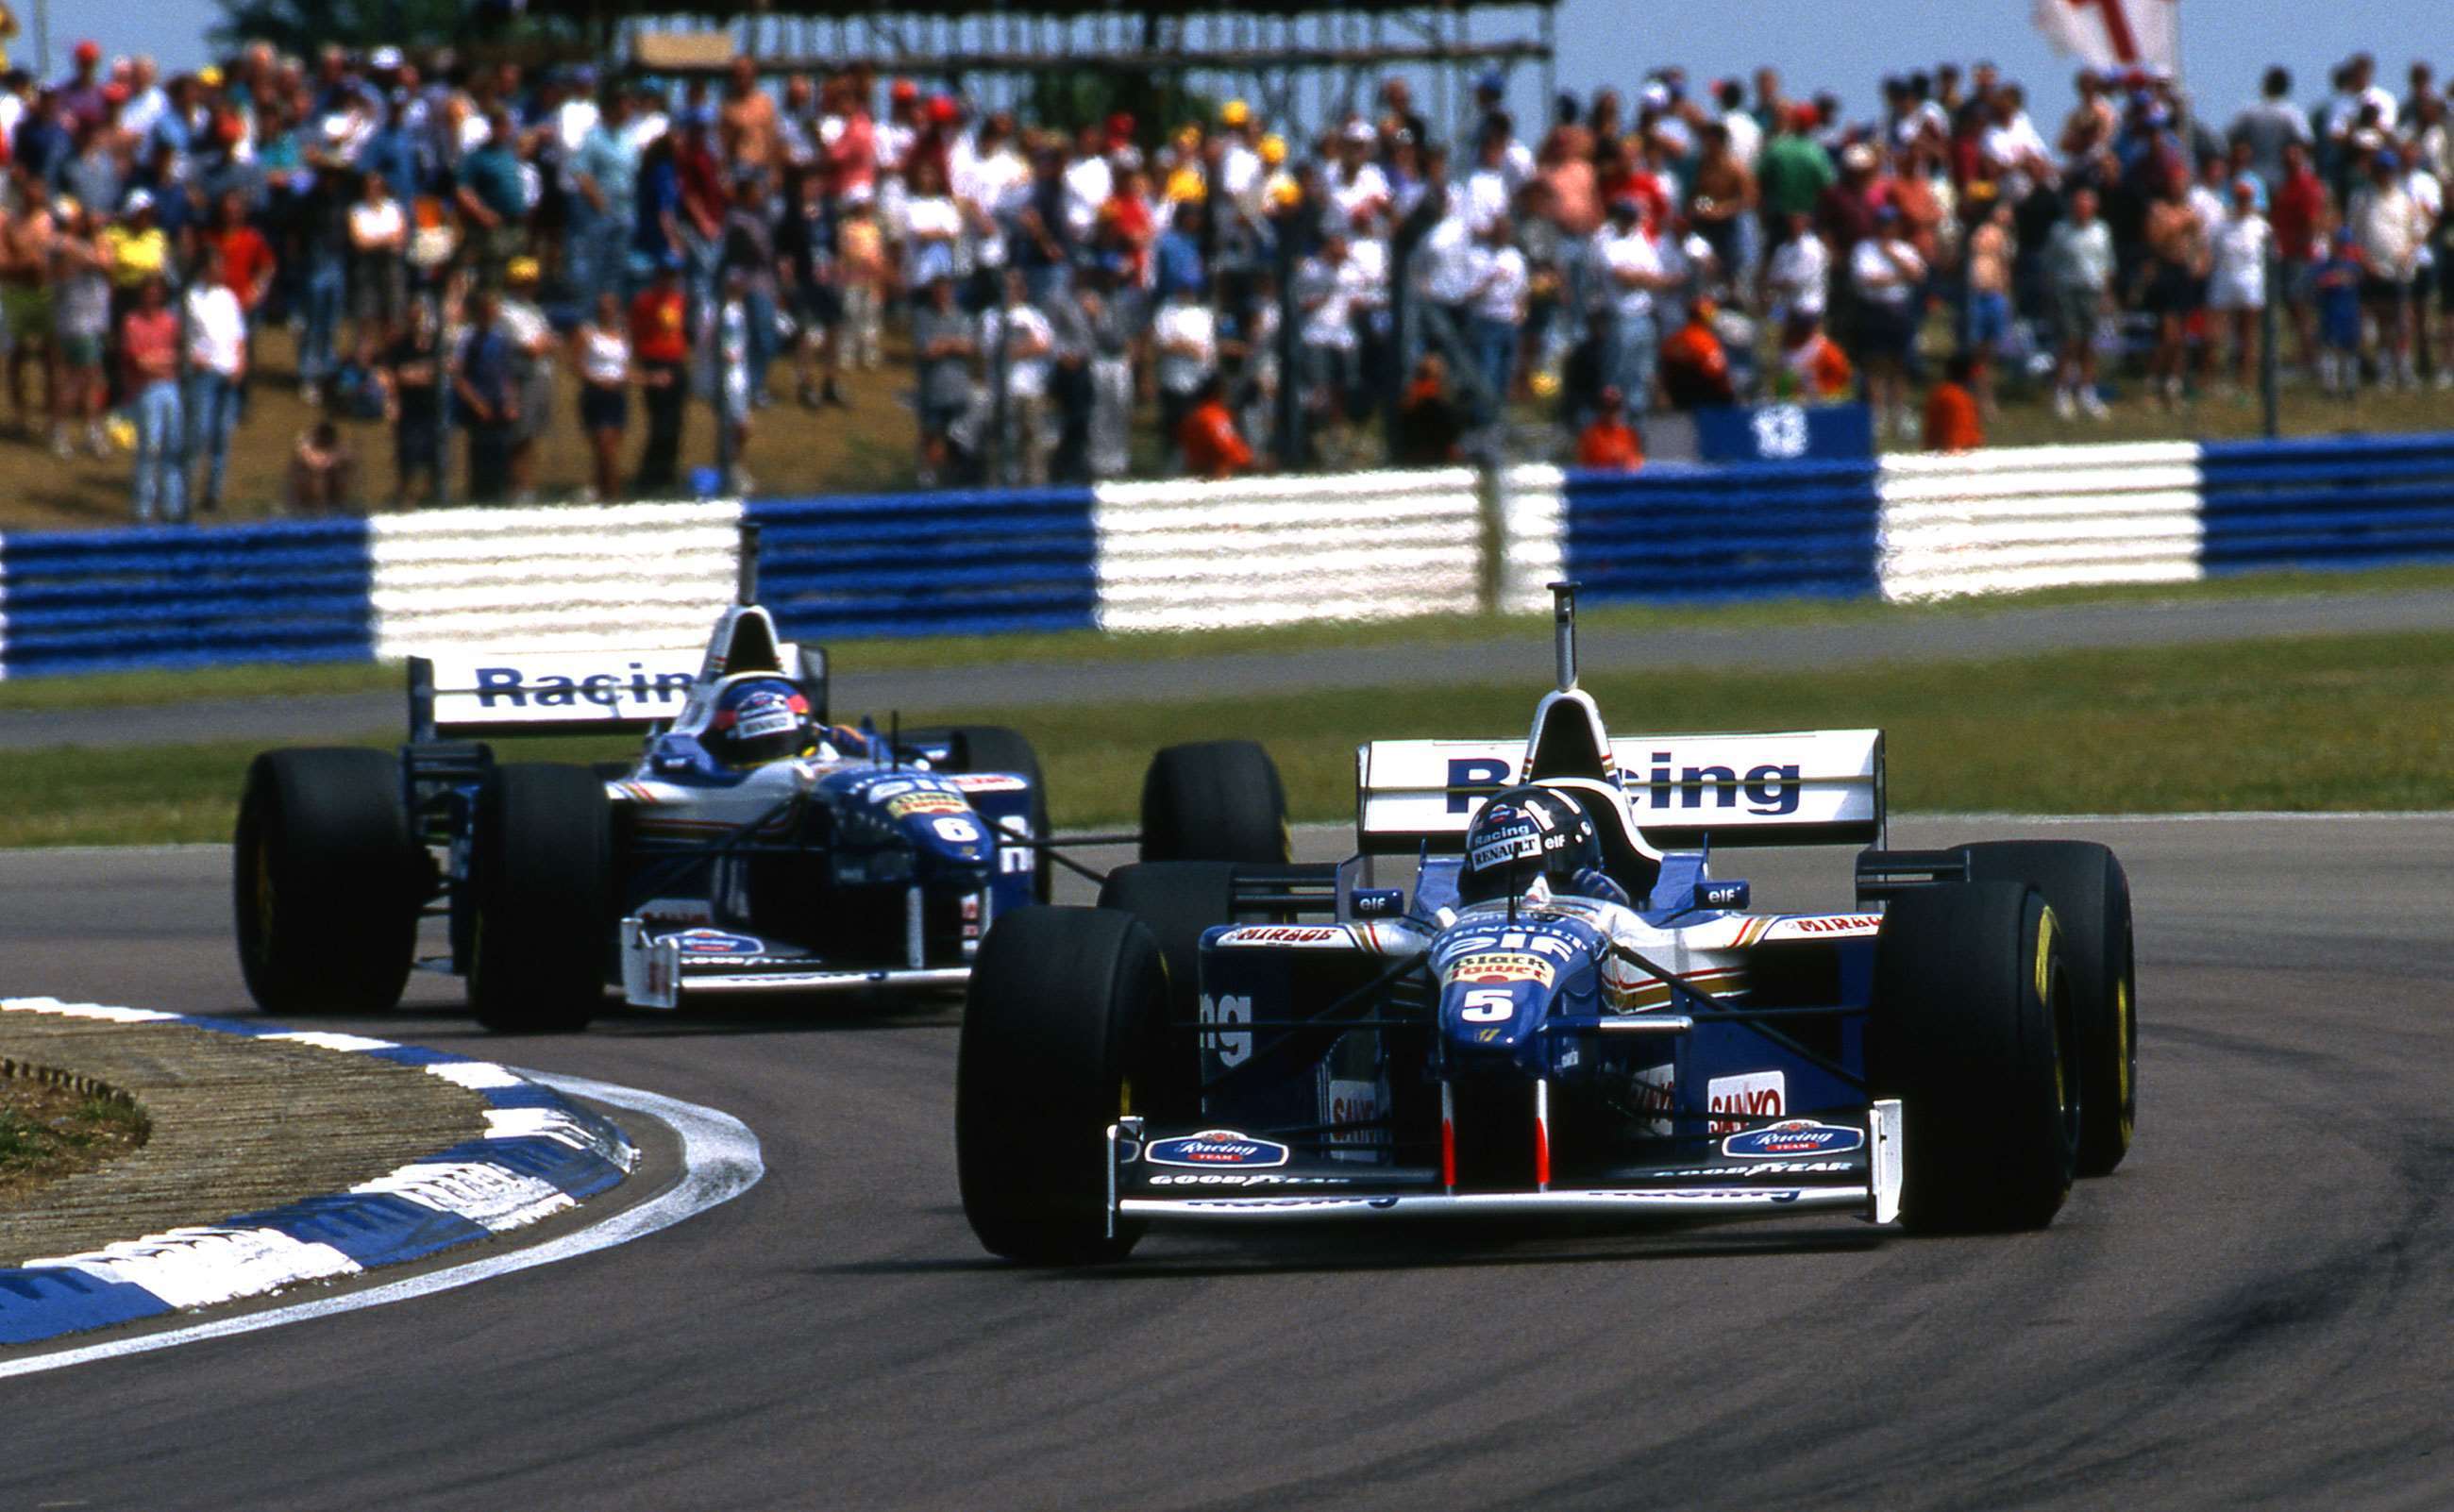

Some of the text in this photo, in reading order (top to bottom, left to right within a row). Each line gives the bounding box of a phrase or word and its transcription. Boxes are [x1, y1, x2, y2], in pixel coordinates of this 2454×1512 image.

[1446, 751, 1802, 816] Ring
[932, 816, 980, 842] 6
[1474, 824, 1531, 848] Racing
[1544, 834, 1566, 849] elf
[1359, 897, 1387, 912] elf
[1708, 889, 1736, 904] elf
[1453, 953, 1547, 971] Black
[1461, 988, 1514, 1023] 5
[1710, 1088, 1782, 1134] SANYO
[1751, 1131, 1834, 1146] Racing
[1775, 1142, 1809, 1151] TEAM
[1176, 1140, 1260, 1155] Racing
